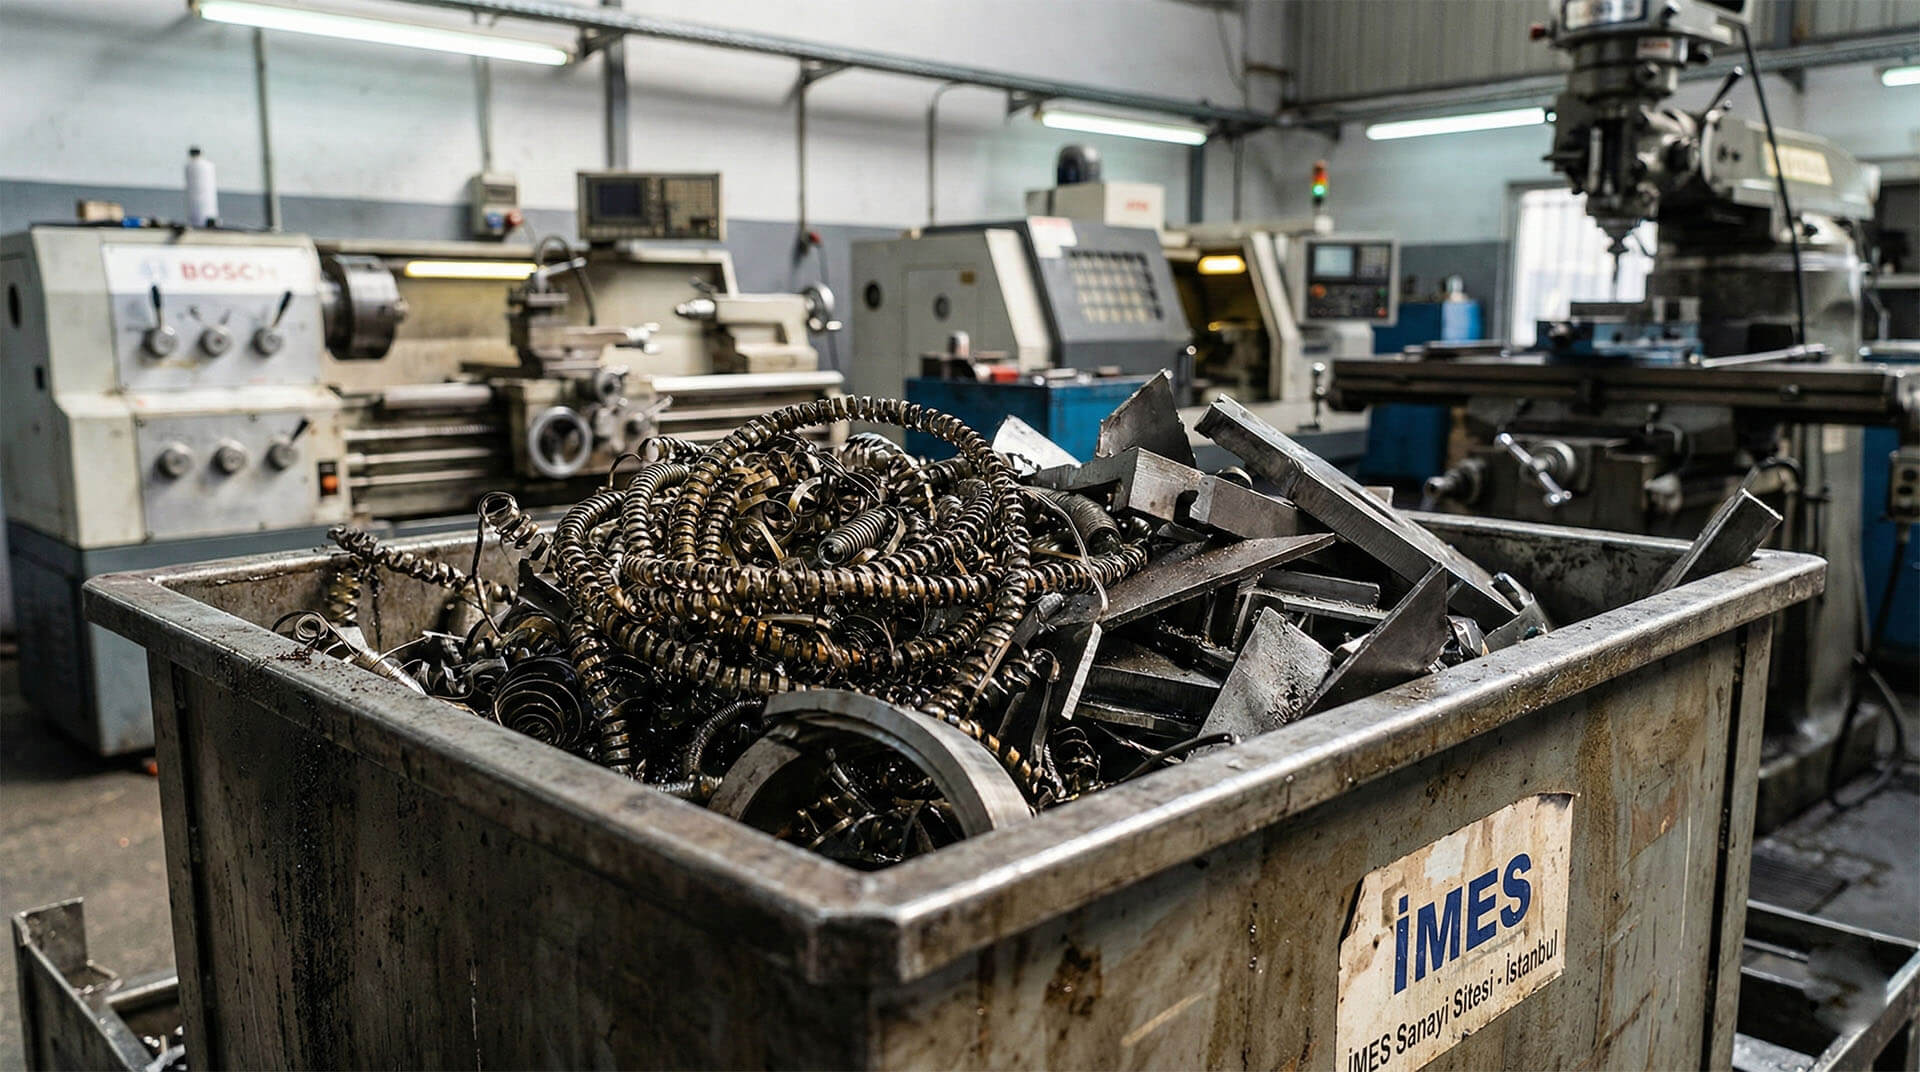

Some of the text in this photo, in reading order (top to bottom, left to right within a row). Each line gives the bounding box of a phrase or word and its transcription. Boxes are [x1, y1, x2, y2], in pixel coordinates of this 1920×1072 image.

[1394, 853, 1532, 995] İMES
[1396, 996, 1449, 1054] Sanayi
[1453, 969, 1493, 1018] Sitesi
[1506, 929, 1558, 986] İstanbul
